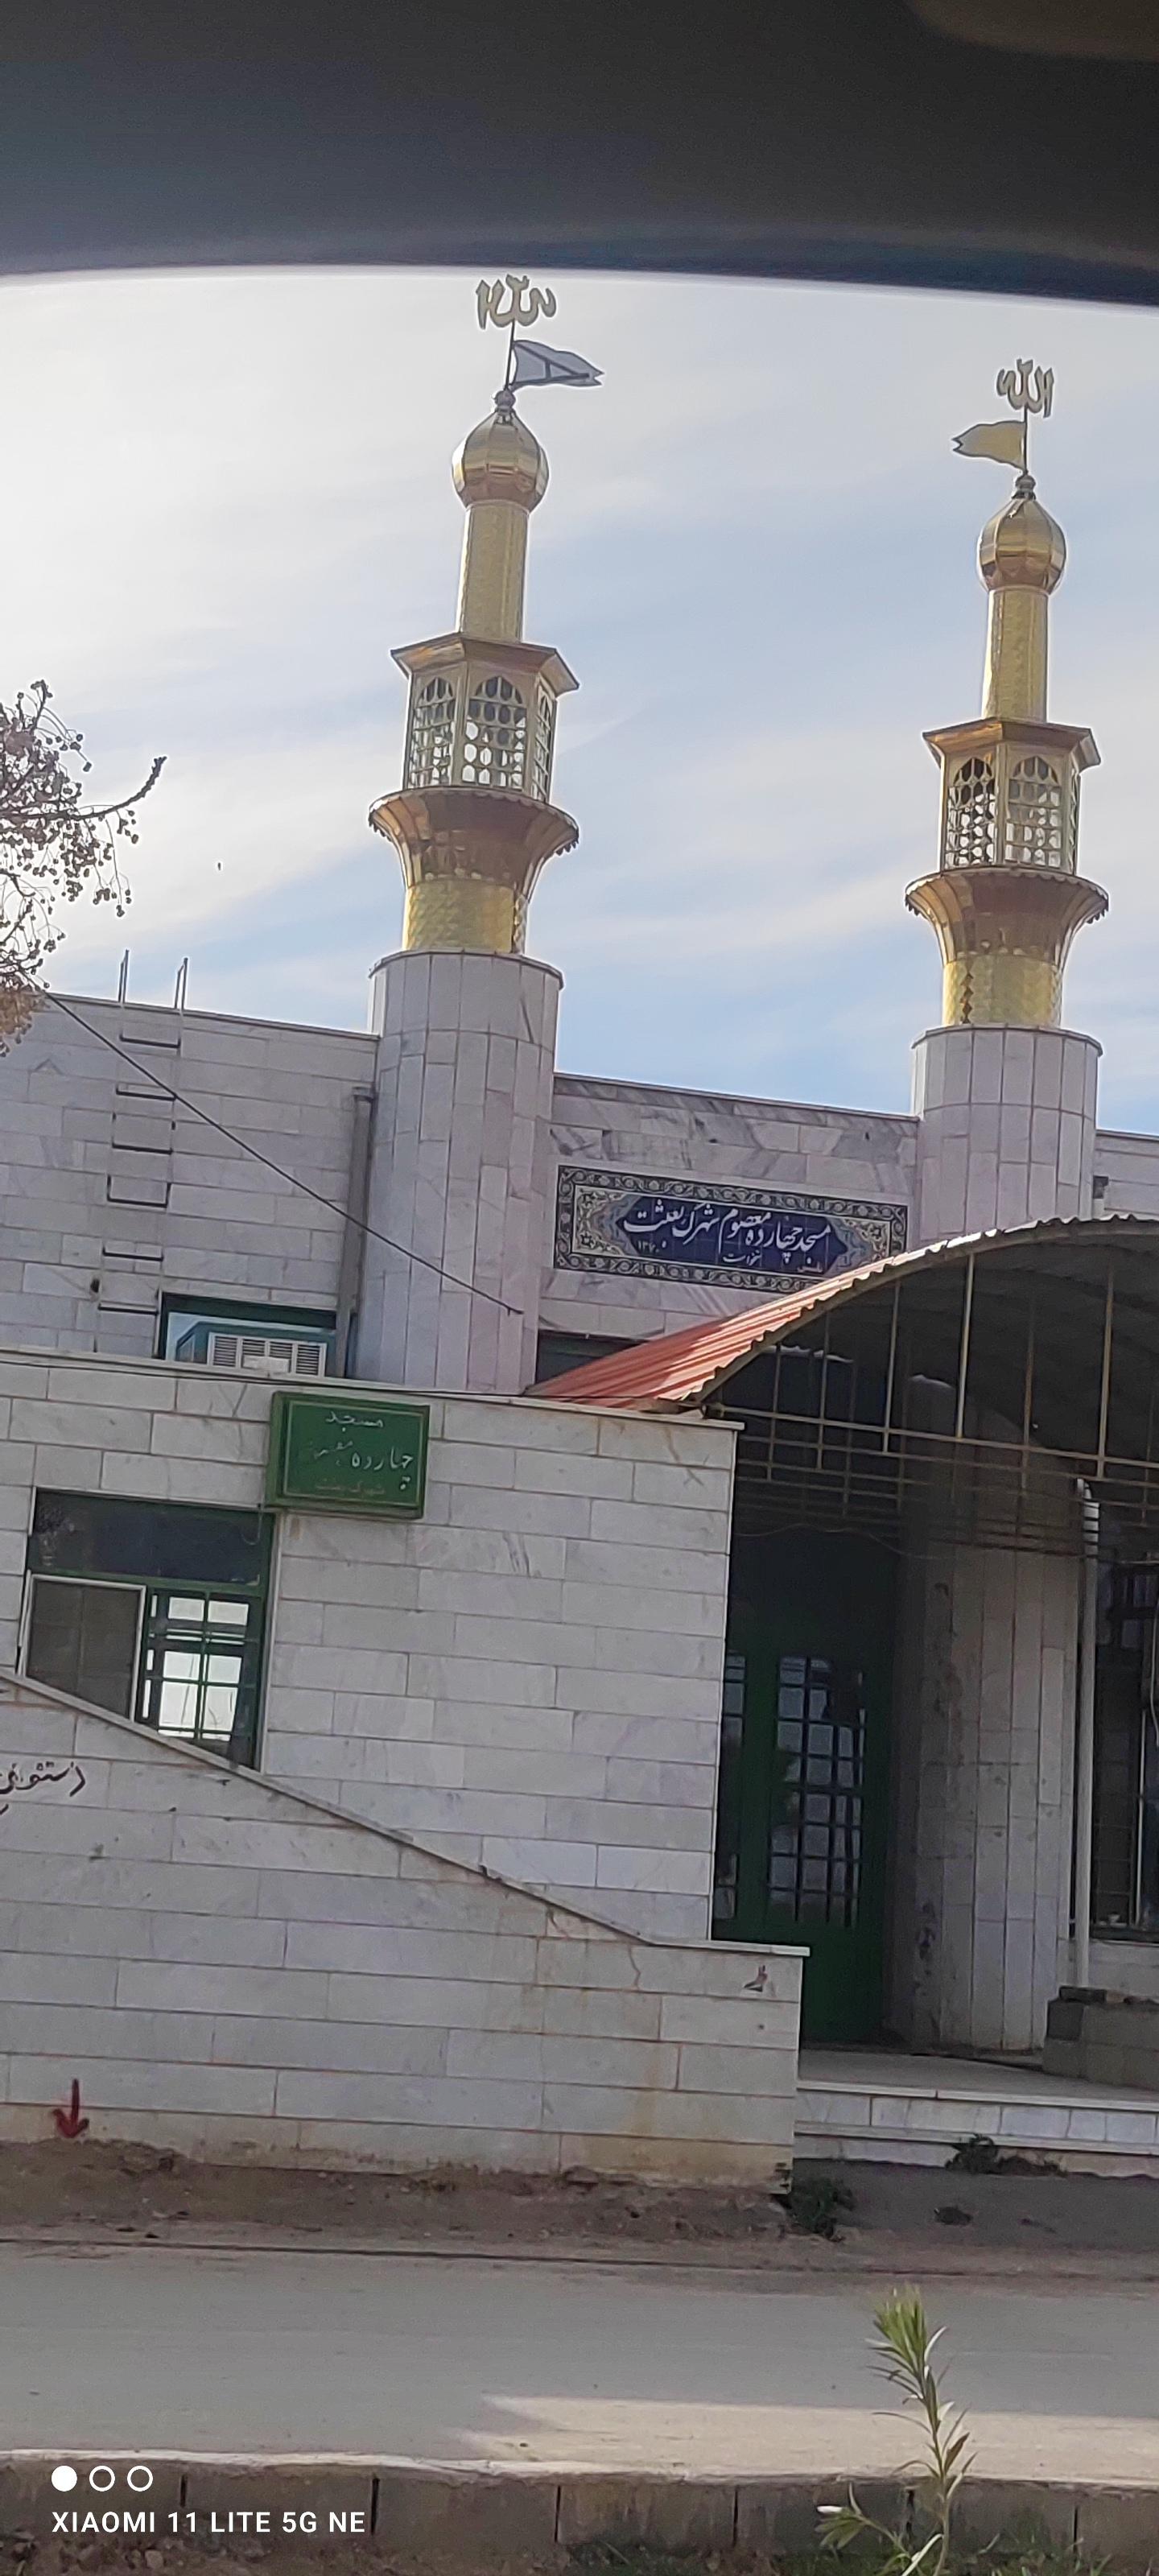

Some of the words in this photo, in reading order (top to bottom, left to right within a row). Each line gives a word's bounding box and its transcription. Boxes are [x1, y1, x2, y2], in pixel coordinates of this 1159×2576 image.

[996, 359, 1054, 418] الله
[624, 1199, 684, 1249] بعثت
[719, 1208, 772, 1254] معصوم
[745, 1221, 803, 1264] چهارده
[788, 1224, 831, 1265] مسجد
[325, 1411, 384, 1432] مسجد
